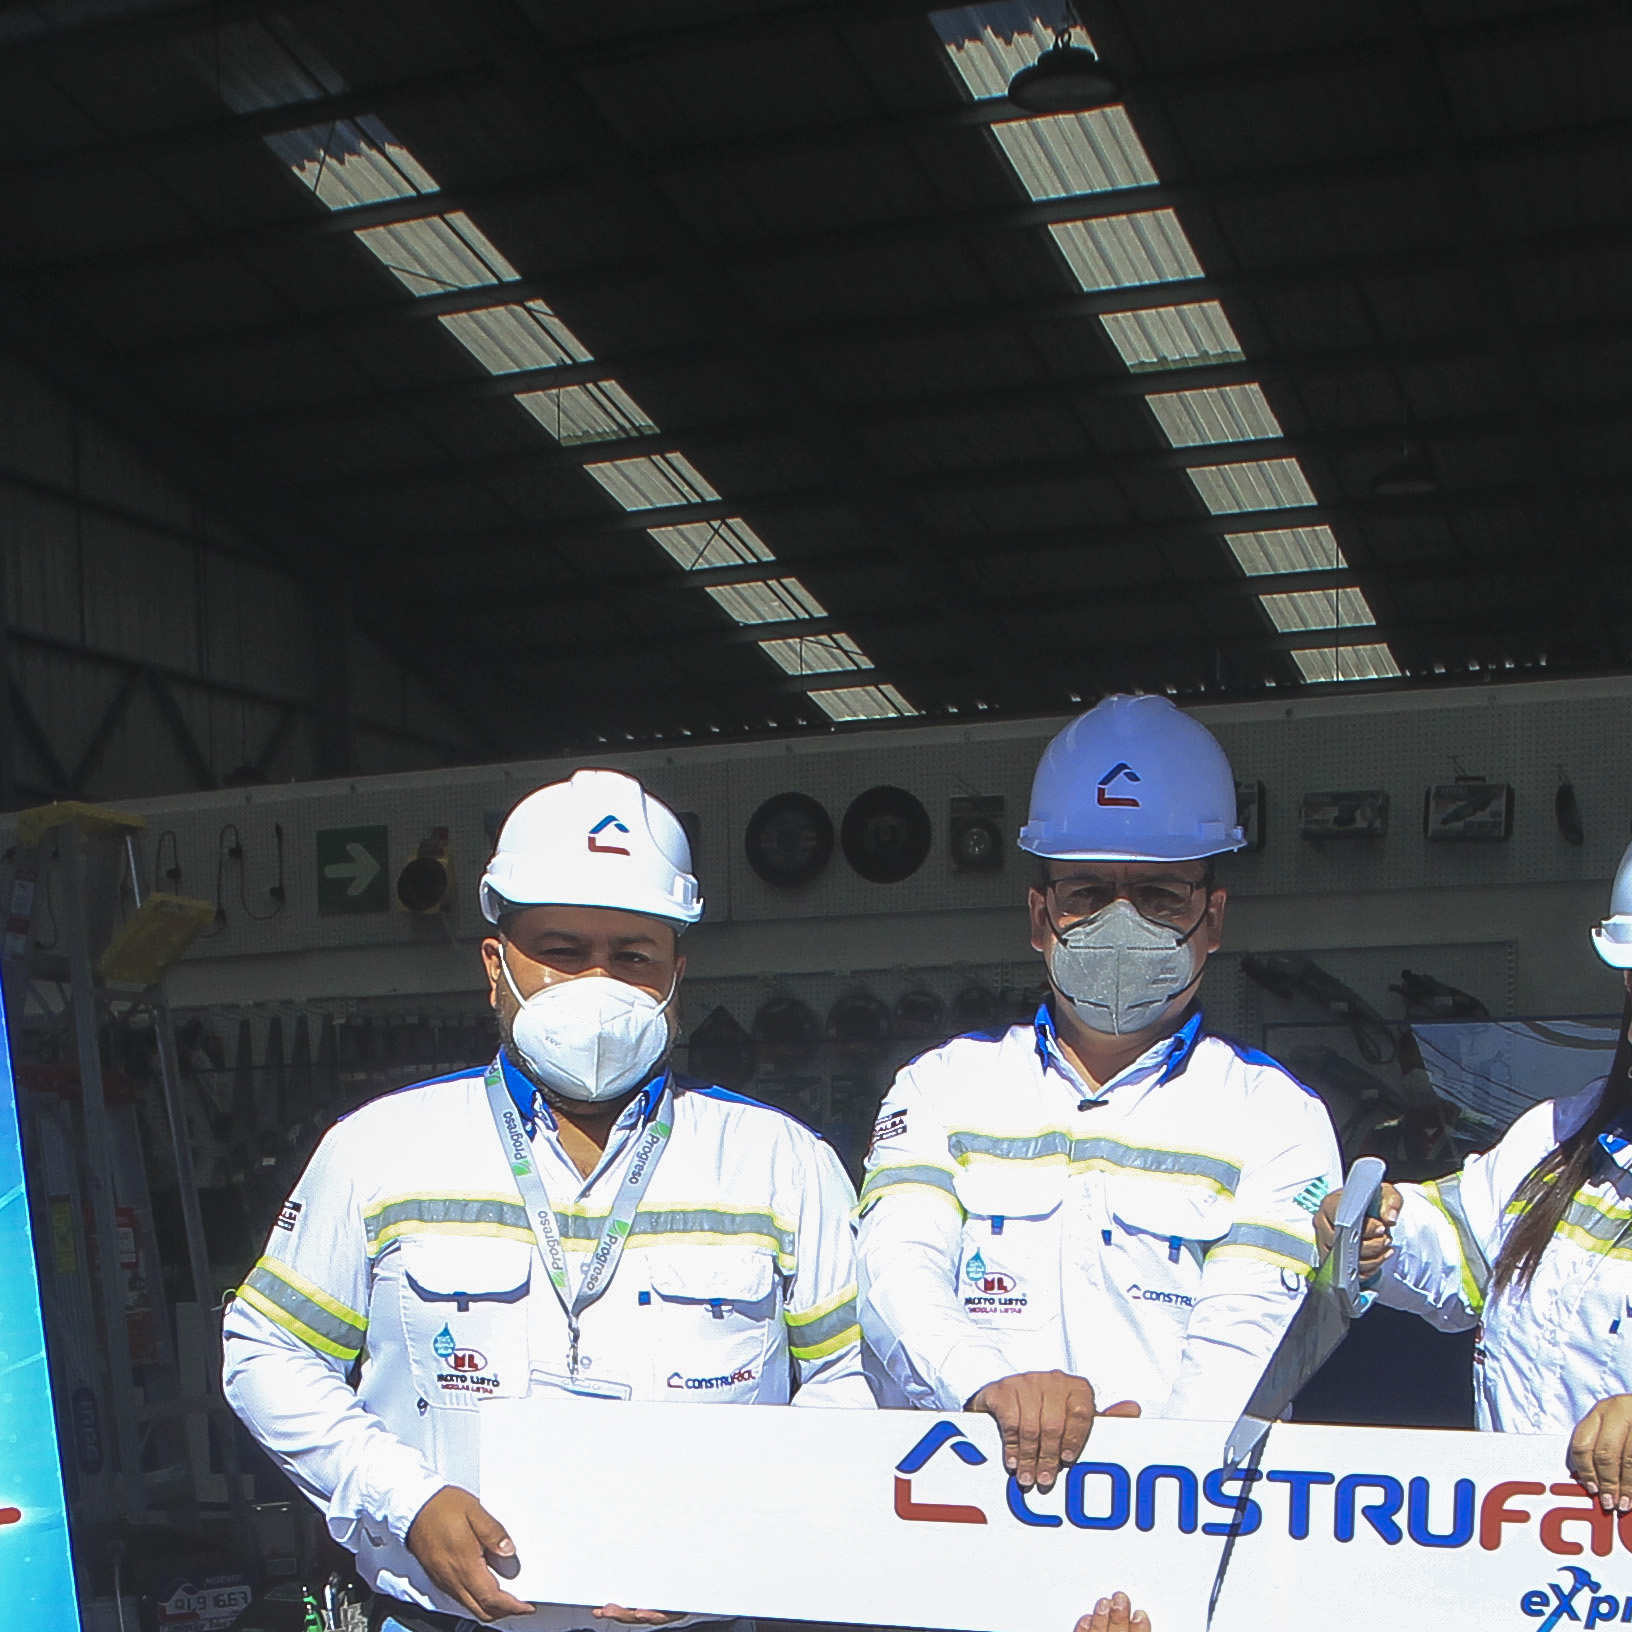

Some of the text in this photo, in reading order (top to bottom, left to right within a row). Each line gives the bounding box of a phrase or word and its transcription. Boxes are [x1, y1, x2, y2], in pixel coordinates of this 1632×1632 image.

[502, 1111, 528, 1161] Progreso
[628, 1132, 661, 1185] Progreso
[537, 1210, 564, 1271] Progreso
[586, 1233, 619, 1292] Progreso
